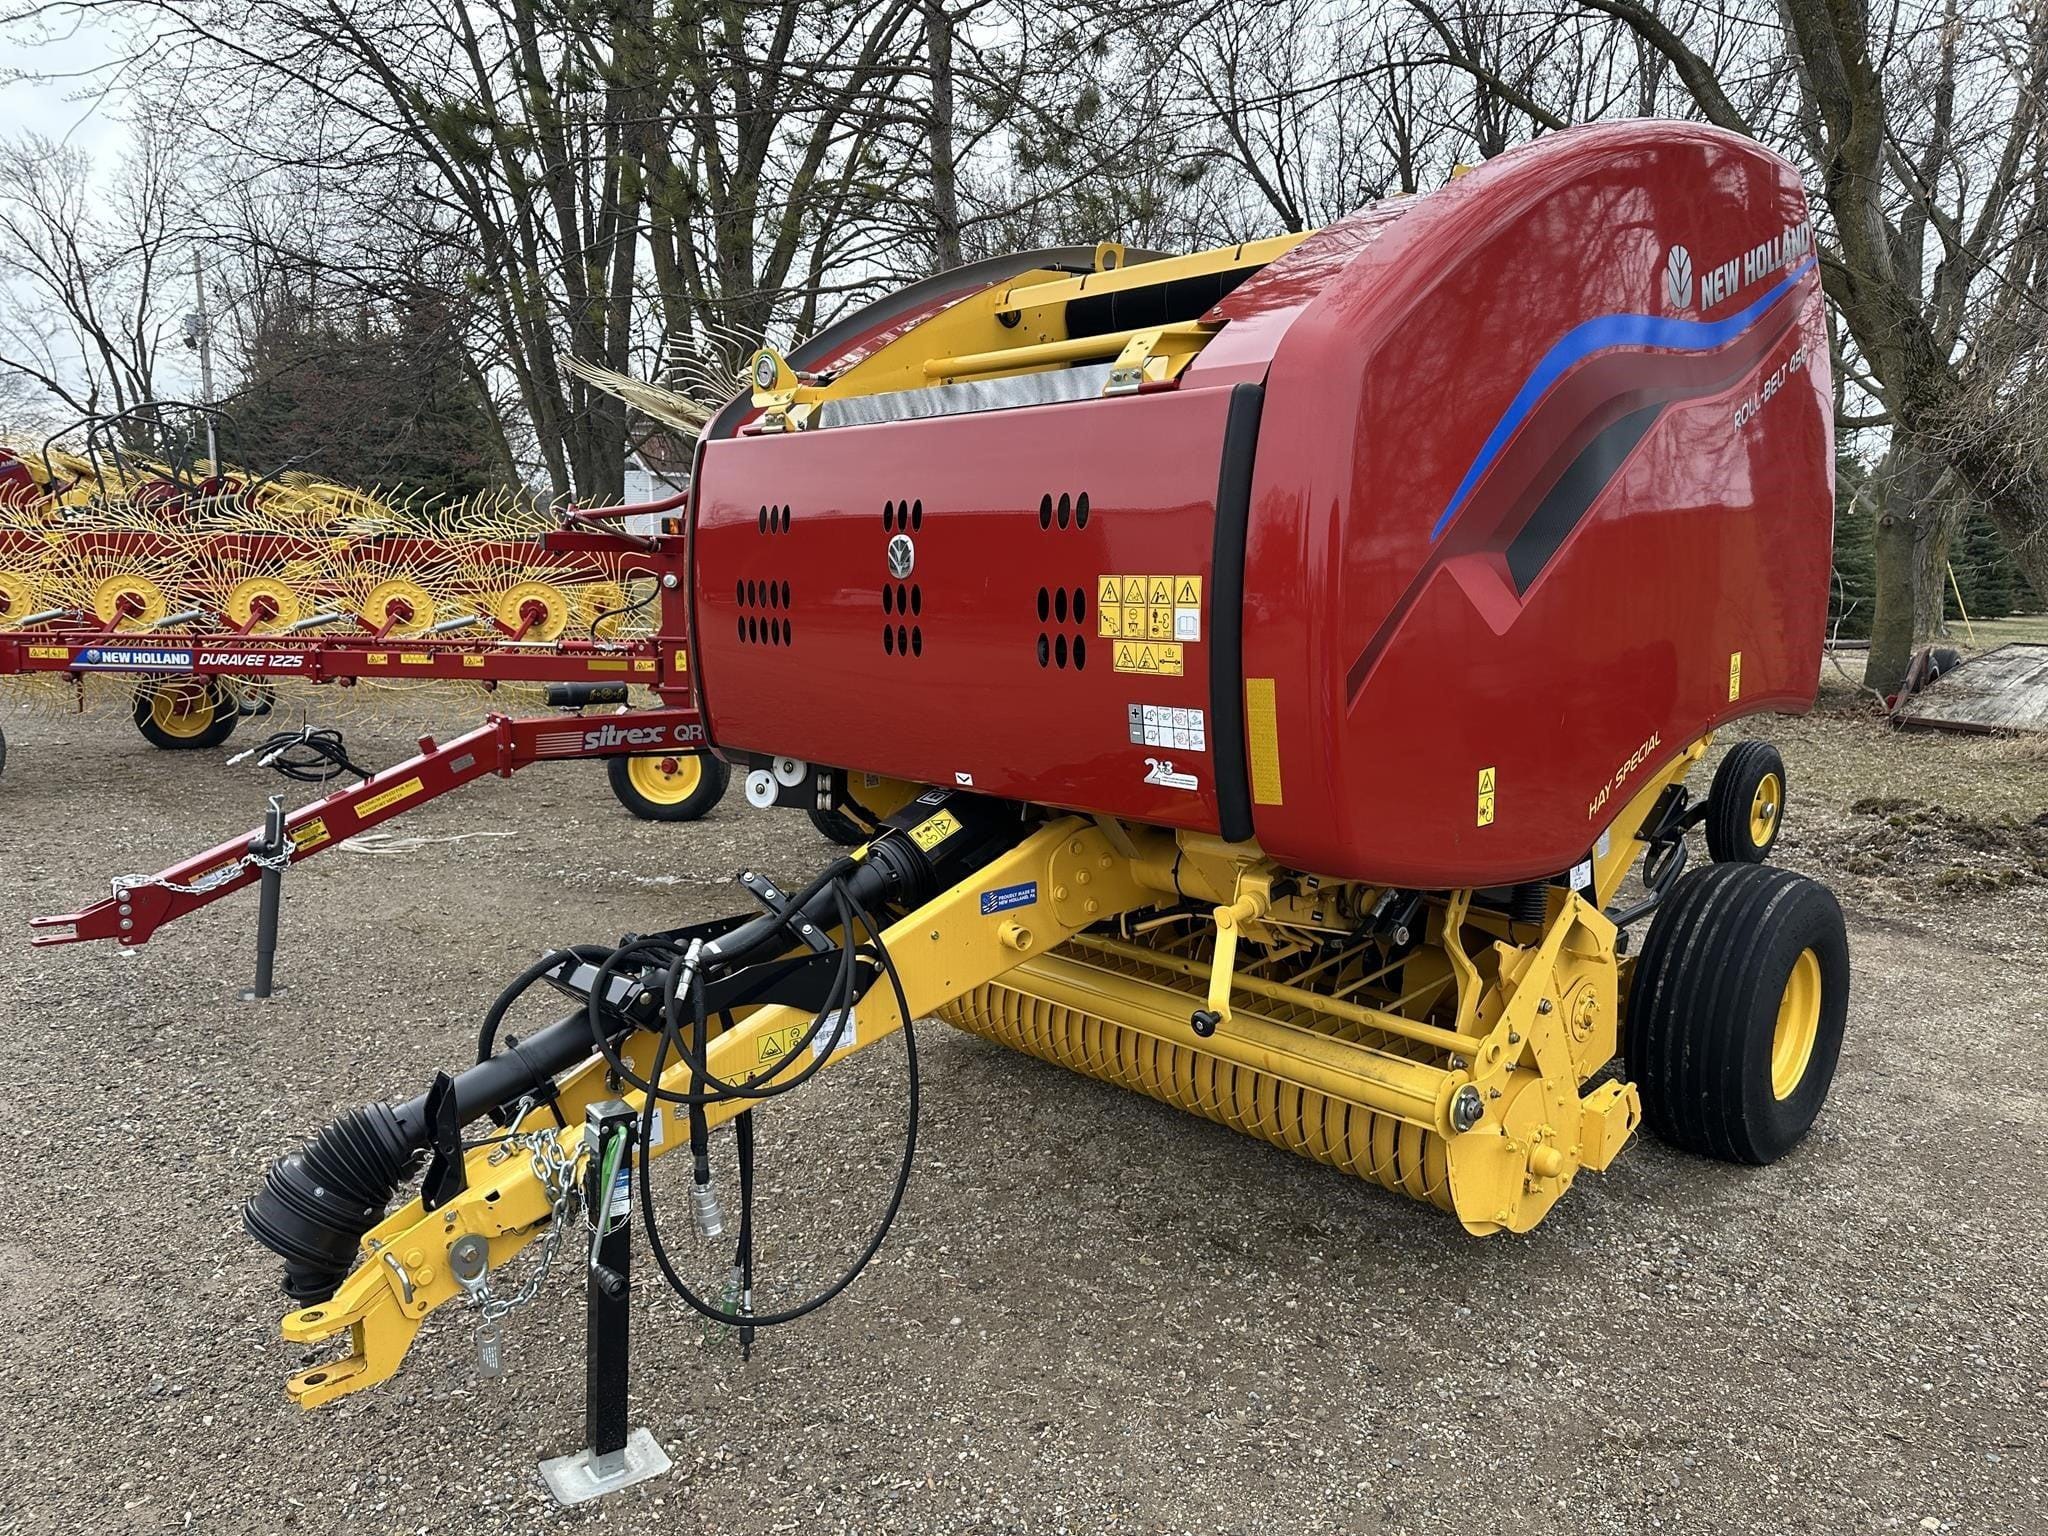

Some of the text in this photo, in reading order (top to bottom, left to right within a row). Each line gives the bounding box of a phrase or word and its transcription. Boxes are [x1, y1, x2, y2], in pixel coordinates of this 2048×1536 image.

[1701, 220, 1810, 312] NEW HOLLAND
[1734, 343, 1808, 433] ROLL-BELT 450
[101, 651, 190, 665] NEW HOLLAND
[198, 652, 305, 667] DURAVEE 1225
[584, 724, 667, 750] sitrex
[1588, 730, 1661, 821] HAY SPECIAL
